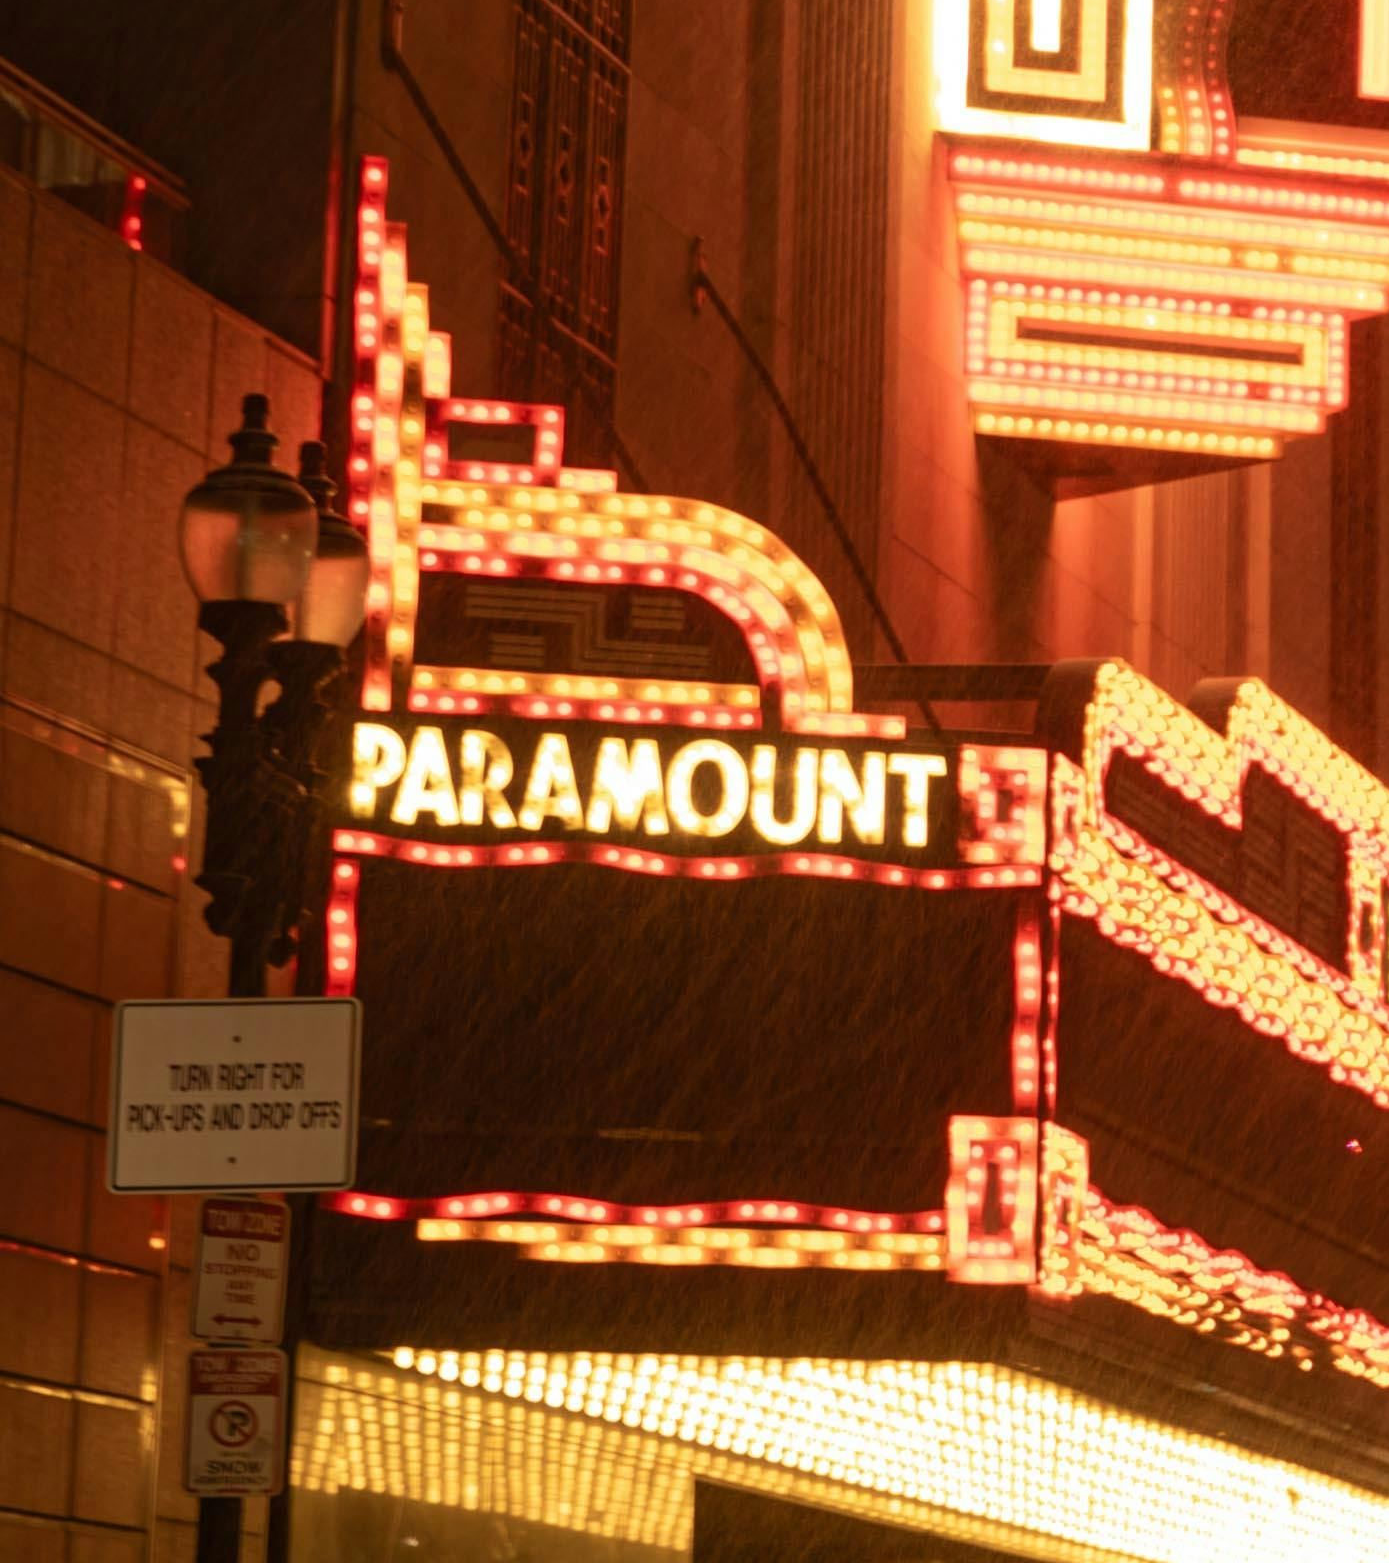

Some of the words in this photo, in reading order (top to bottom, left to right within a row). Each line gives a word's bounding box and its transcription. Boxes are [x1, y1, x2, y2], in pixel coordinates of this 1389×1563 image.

[349, 721, 948, 847] PARAMOUNT
[167, 1063, 212, 1091] TURN
[217, 1062, 266, 1091] RIGHT
[270, 1062, 304, 1090] FOR
[127, 1103, 204, 1132] PICK-UPS
[210, 1102, 245, 1130] AND
[250, 1102, 294, 1130] DROP
[301, 1100, 341, 1129] OFFS
[206, 1208, 238, 1231] TOW
[242, 1210, 282, 1235] ZONE
[226, 1243, 261, 1262] NO
[205, 1262, 278, 1280] STOPPING
[207, 1460, 263, 1475] SNOW
